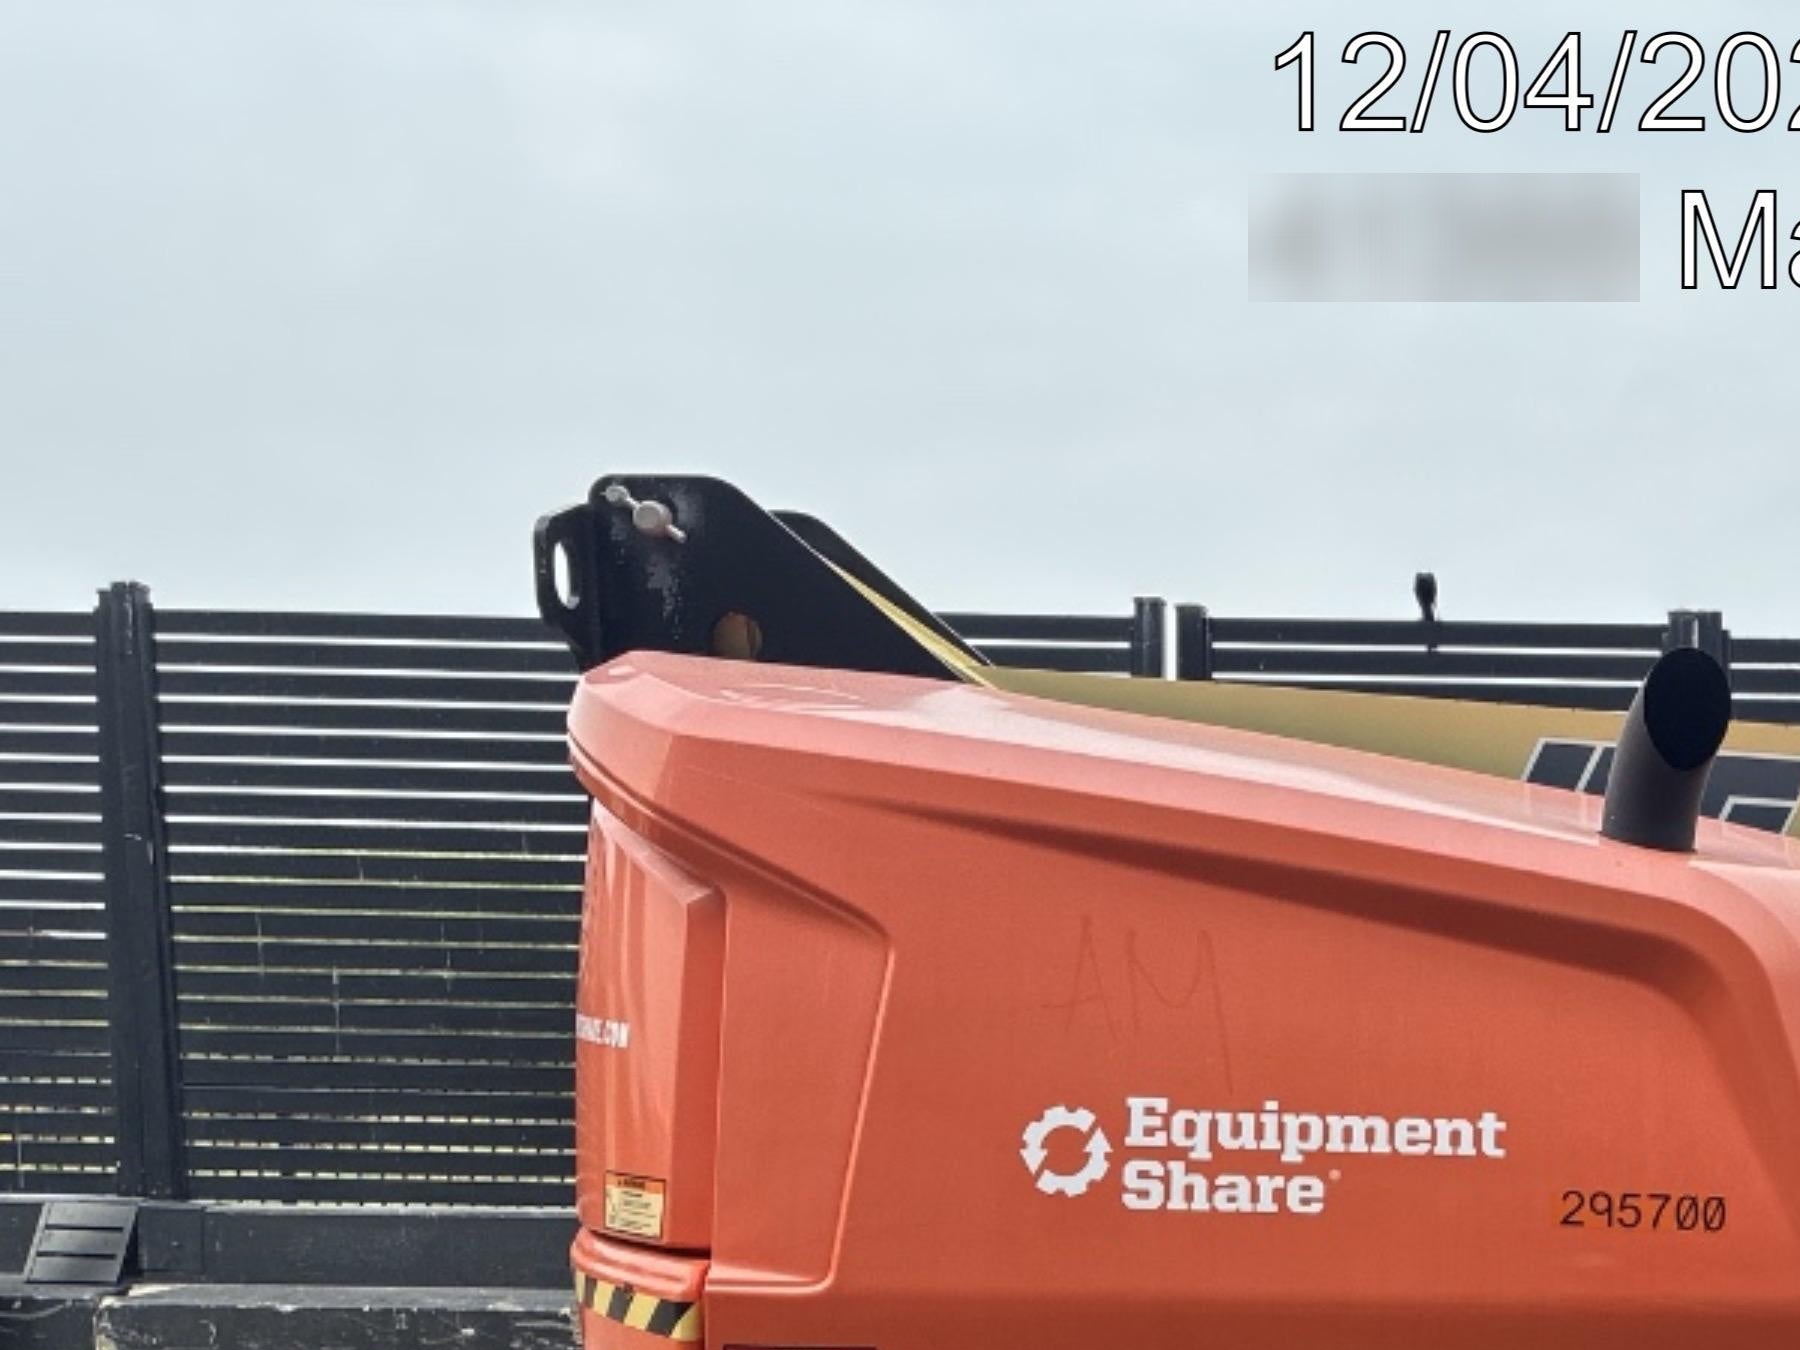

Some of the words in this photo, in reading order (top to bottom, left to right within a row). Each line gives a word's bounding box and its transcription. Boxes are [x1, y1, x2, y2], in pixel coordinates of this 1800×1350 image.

[1122, 1096, 1508, 1164] Equipment
[1121, 1159, 1326, 1215] Share
[1558, 1189, 1729, 1233] 295700
